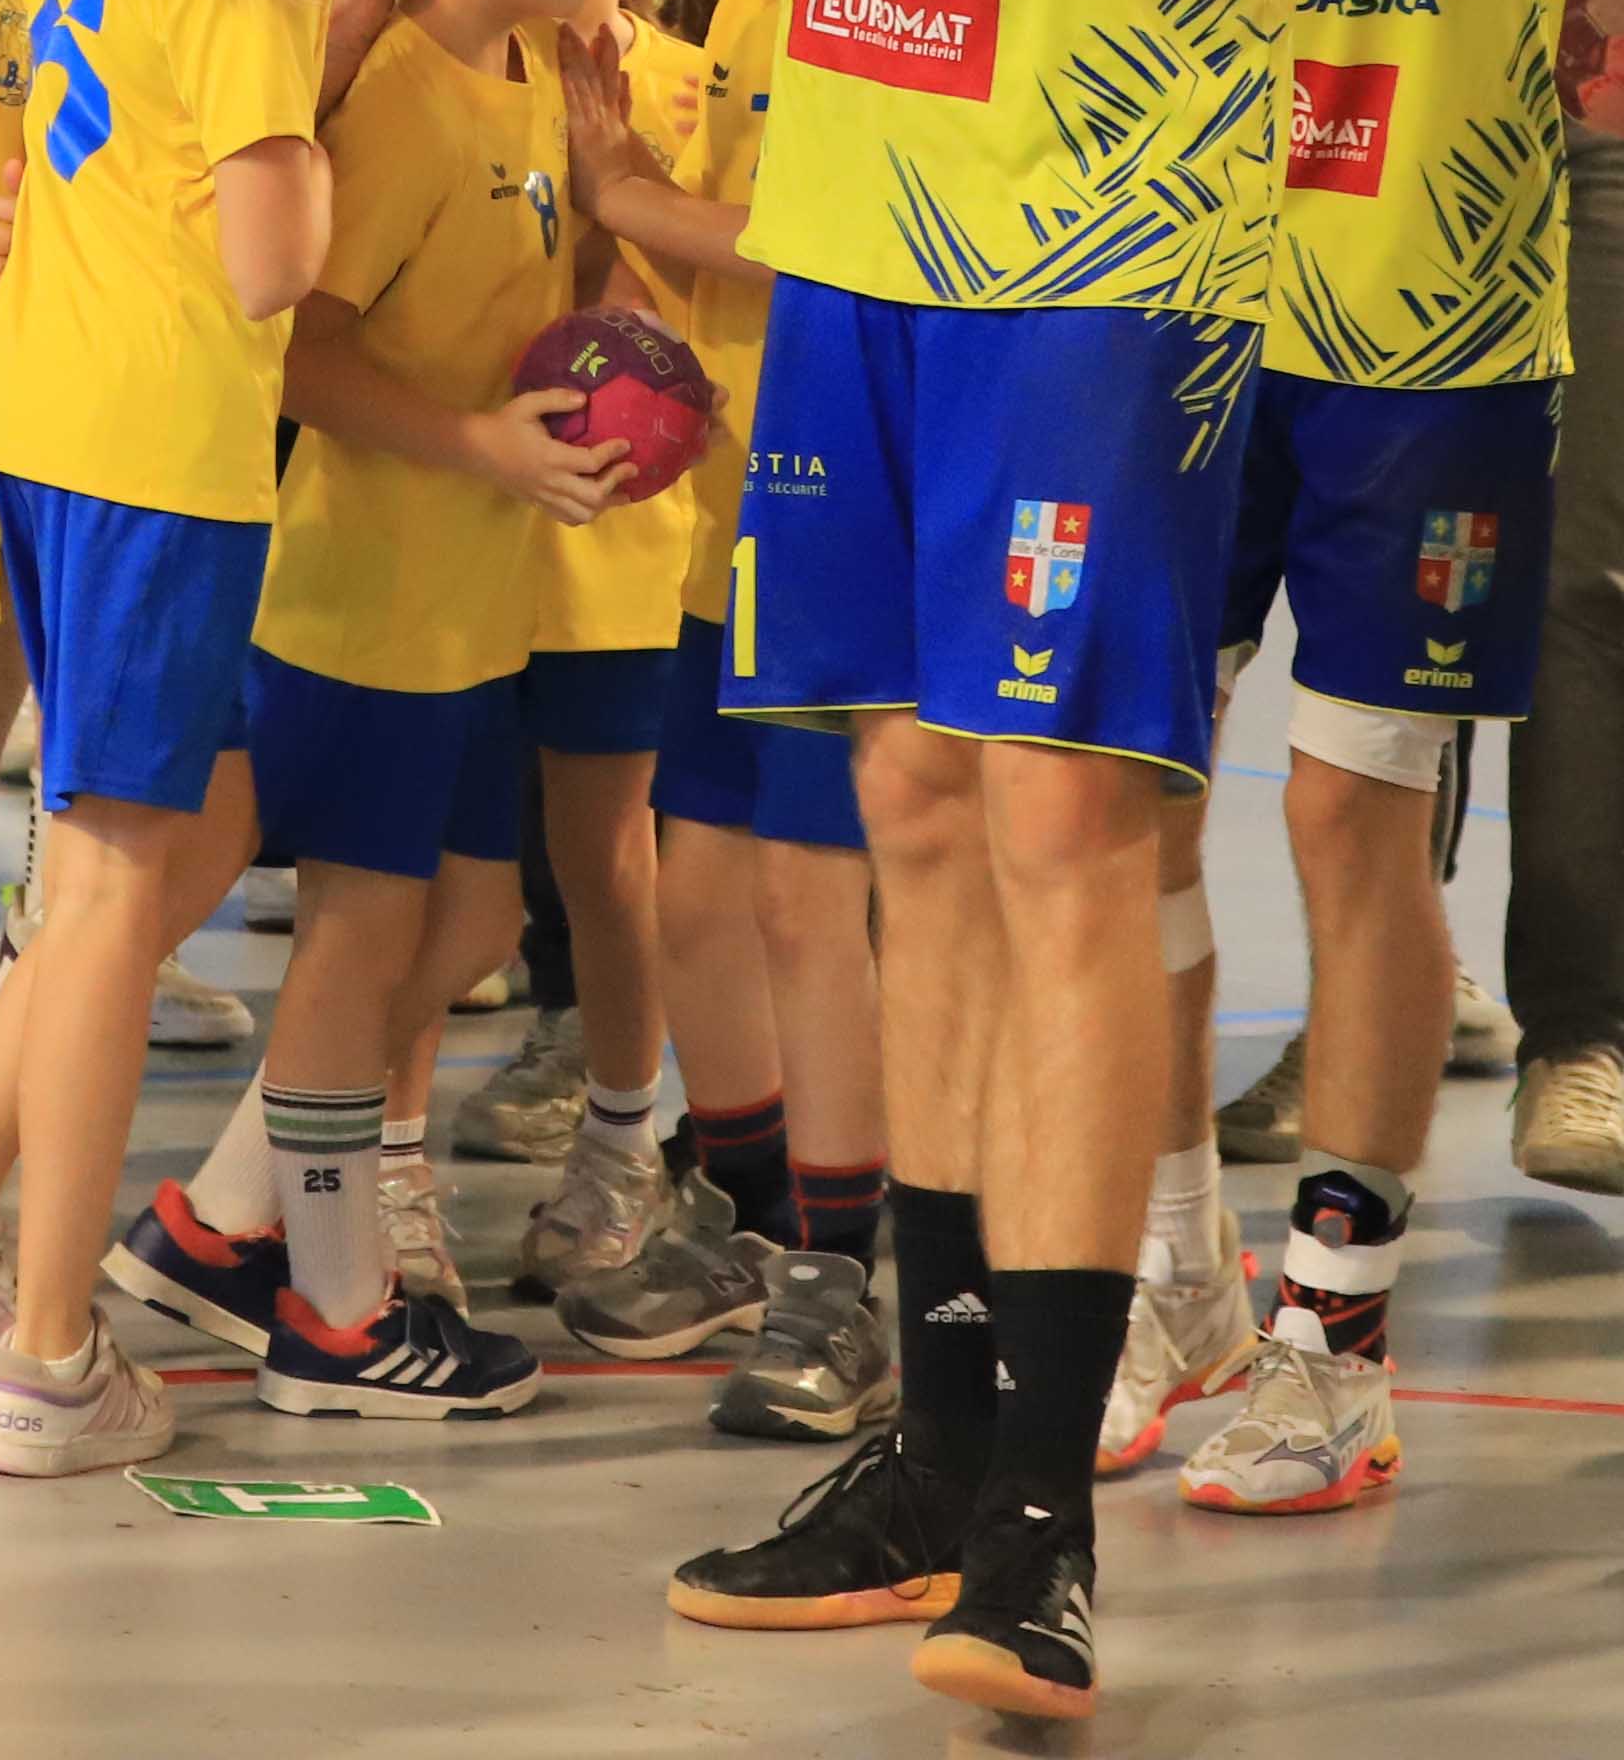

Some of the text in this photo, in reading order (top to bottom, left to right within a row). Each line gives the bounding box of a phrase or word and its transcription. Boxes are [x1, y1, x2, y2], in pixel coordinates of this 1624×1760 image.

[903, 39, 963, 62] matériel
[1289, 112, 1380, 149] OMAT
[748, 452, 827, 477] STIA
[731, 536, 757, 678] 1
[997, 677, 1059, 705] erima
[1404, 667, 1474, 689] erima
[304, 1167, 342, 1195] 25
